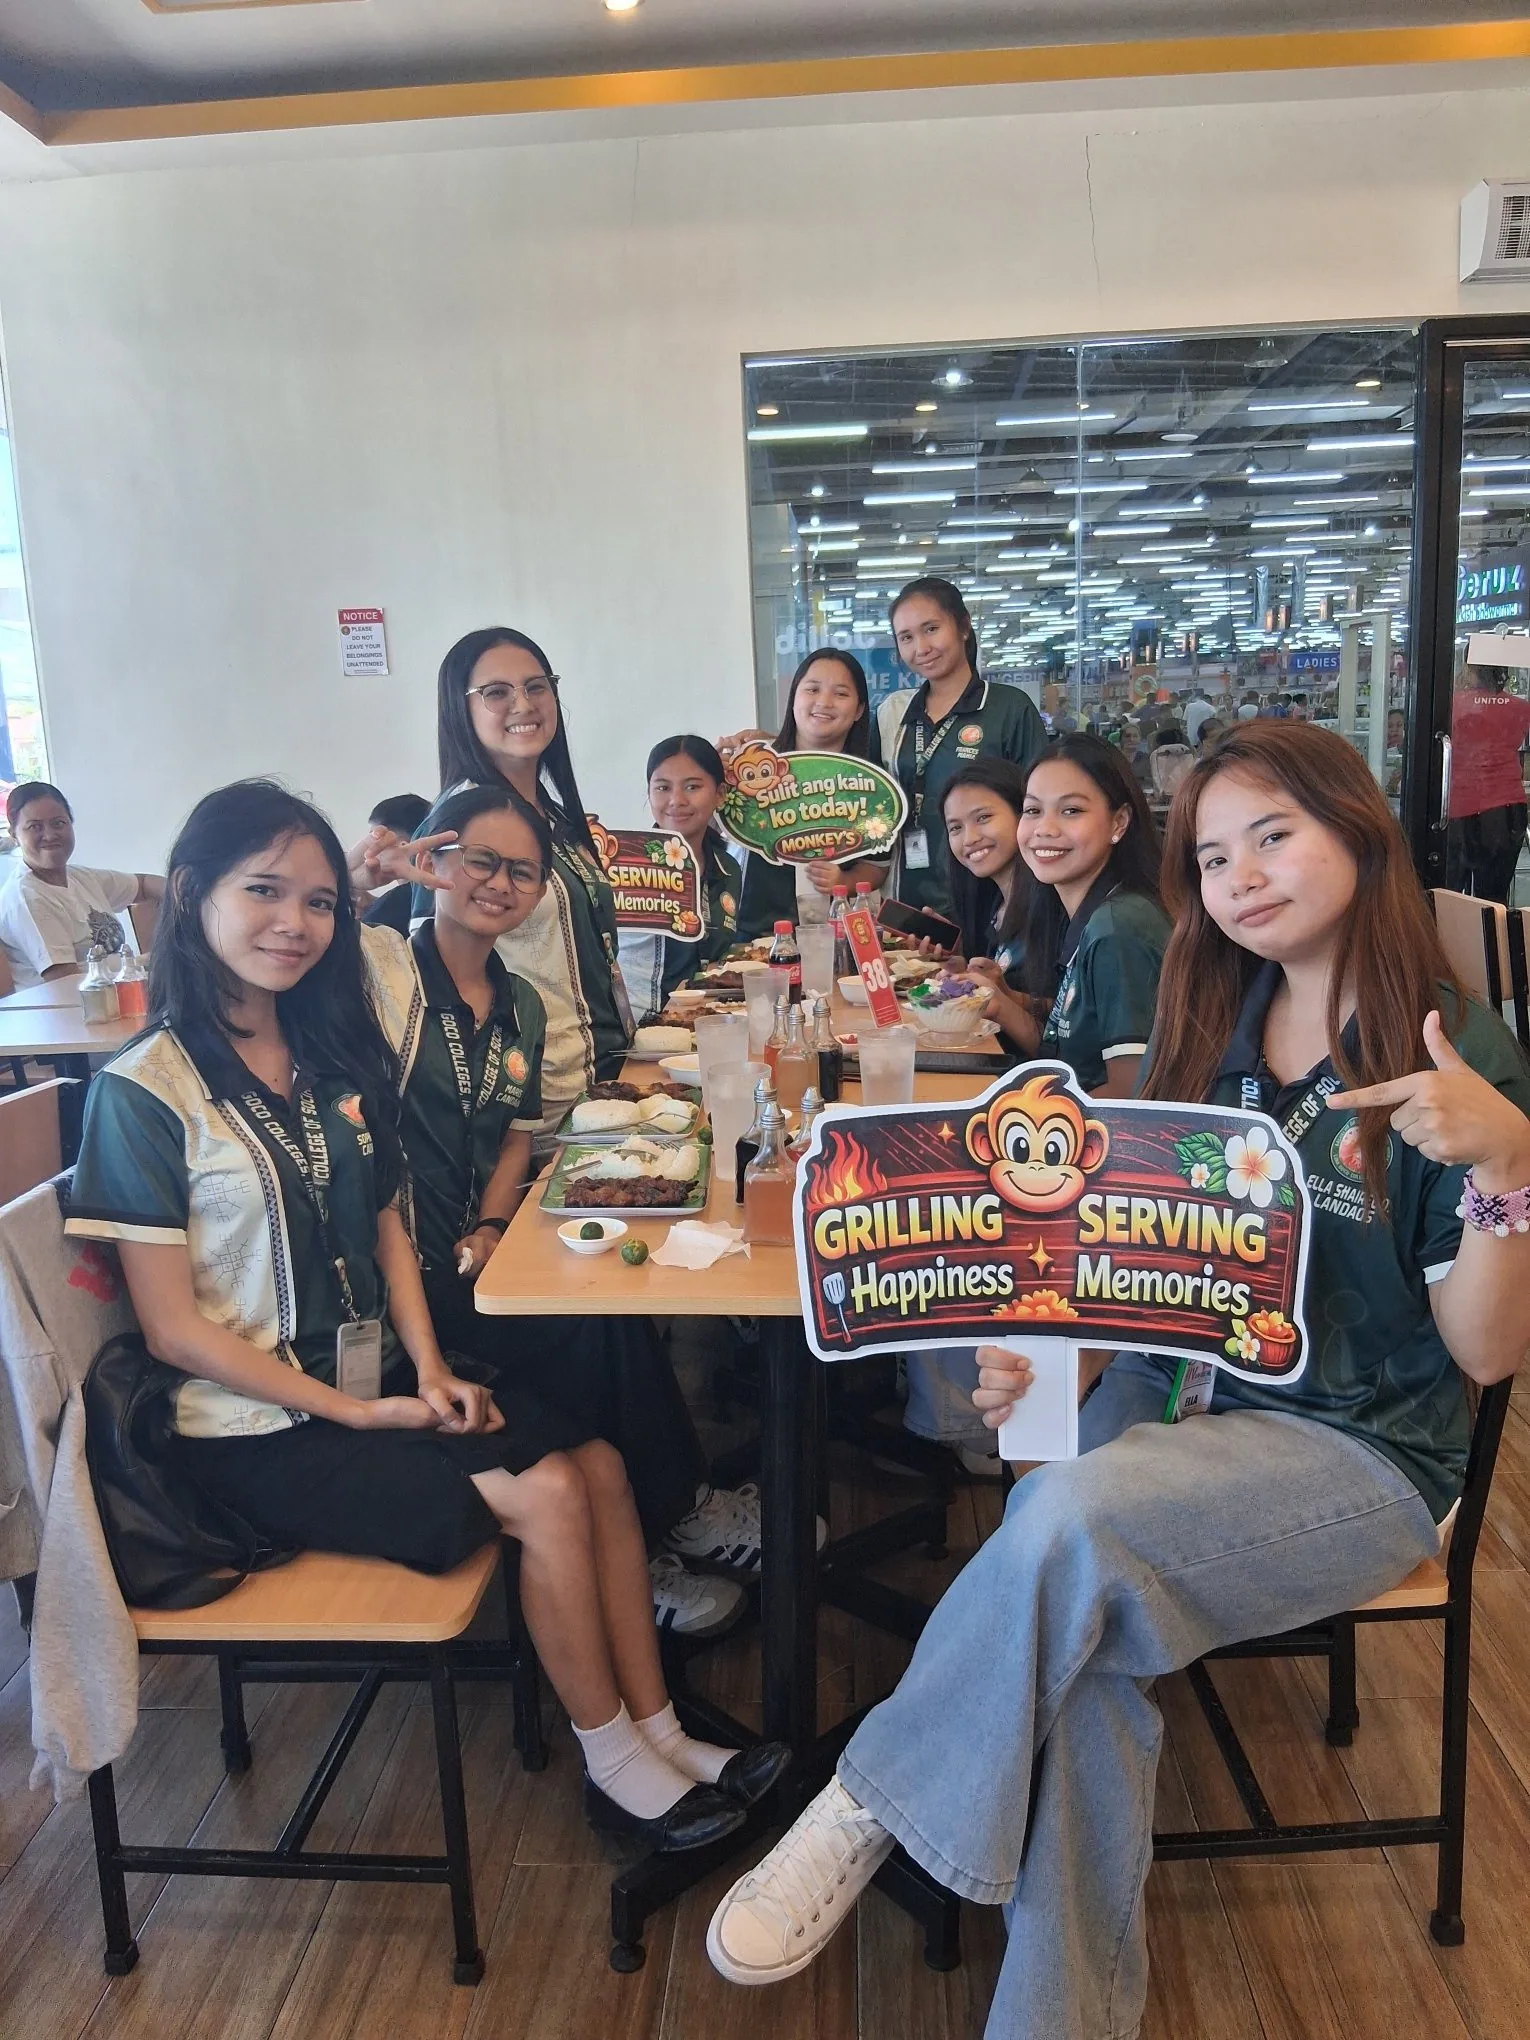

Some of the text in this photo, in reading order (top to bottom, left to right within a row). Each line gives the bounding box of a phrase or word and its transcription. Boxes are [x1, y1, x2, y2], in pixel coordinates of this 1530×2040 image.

[343, 612, 378, 620] NOTICE
[1296, 657, 1338, 668] LADIES
[1474, 697, 1510, 705] UNITOP
[756, 773, 876, 809] Sulit ang kain
[768, 796, 867, 829] ko today!
[781, 830, 856, 854] MONKEY'S
[607, 865, 685, 893] SERVING
[861, 958, 888, 992] 38
[440, 1013, 460, 1040] GOCO
[448, 1042, 472, 1097] COLLEGES,
[488, 1051, 500, 1066] OF
[479, 1063, 500, 1106] COLLEGE
[1301, 1093, 1321, 1118] OF
[241, 1091, 272, 1119] GOCO
[263, 1121, 310, 1177] COLLEGES,
[302, 1115, 321, 1130] OF
[306, 1131, 331, 1180] COLLEGE
[1306, 1174, 1334, 1195] ELLA
[813, 1193, 1267, 1263] GRILLING SERVING
[850, 1253, 1252, 1317] Happiness Memories
